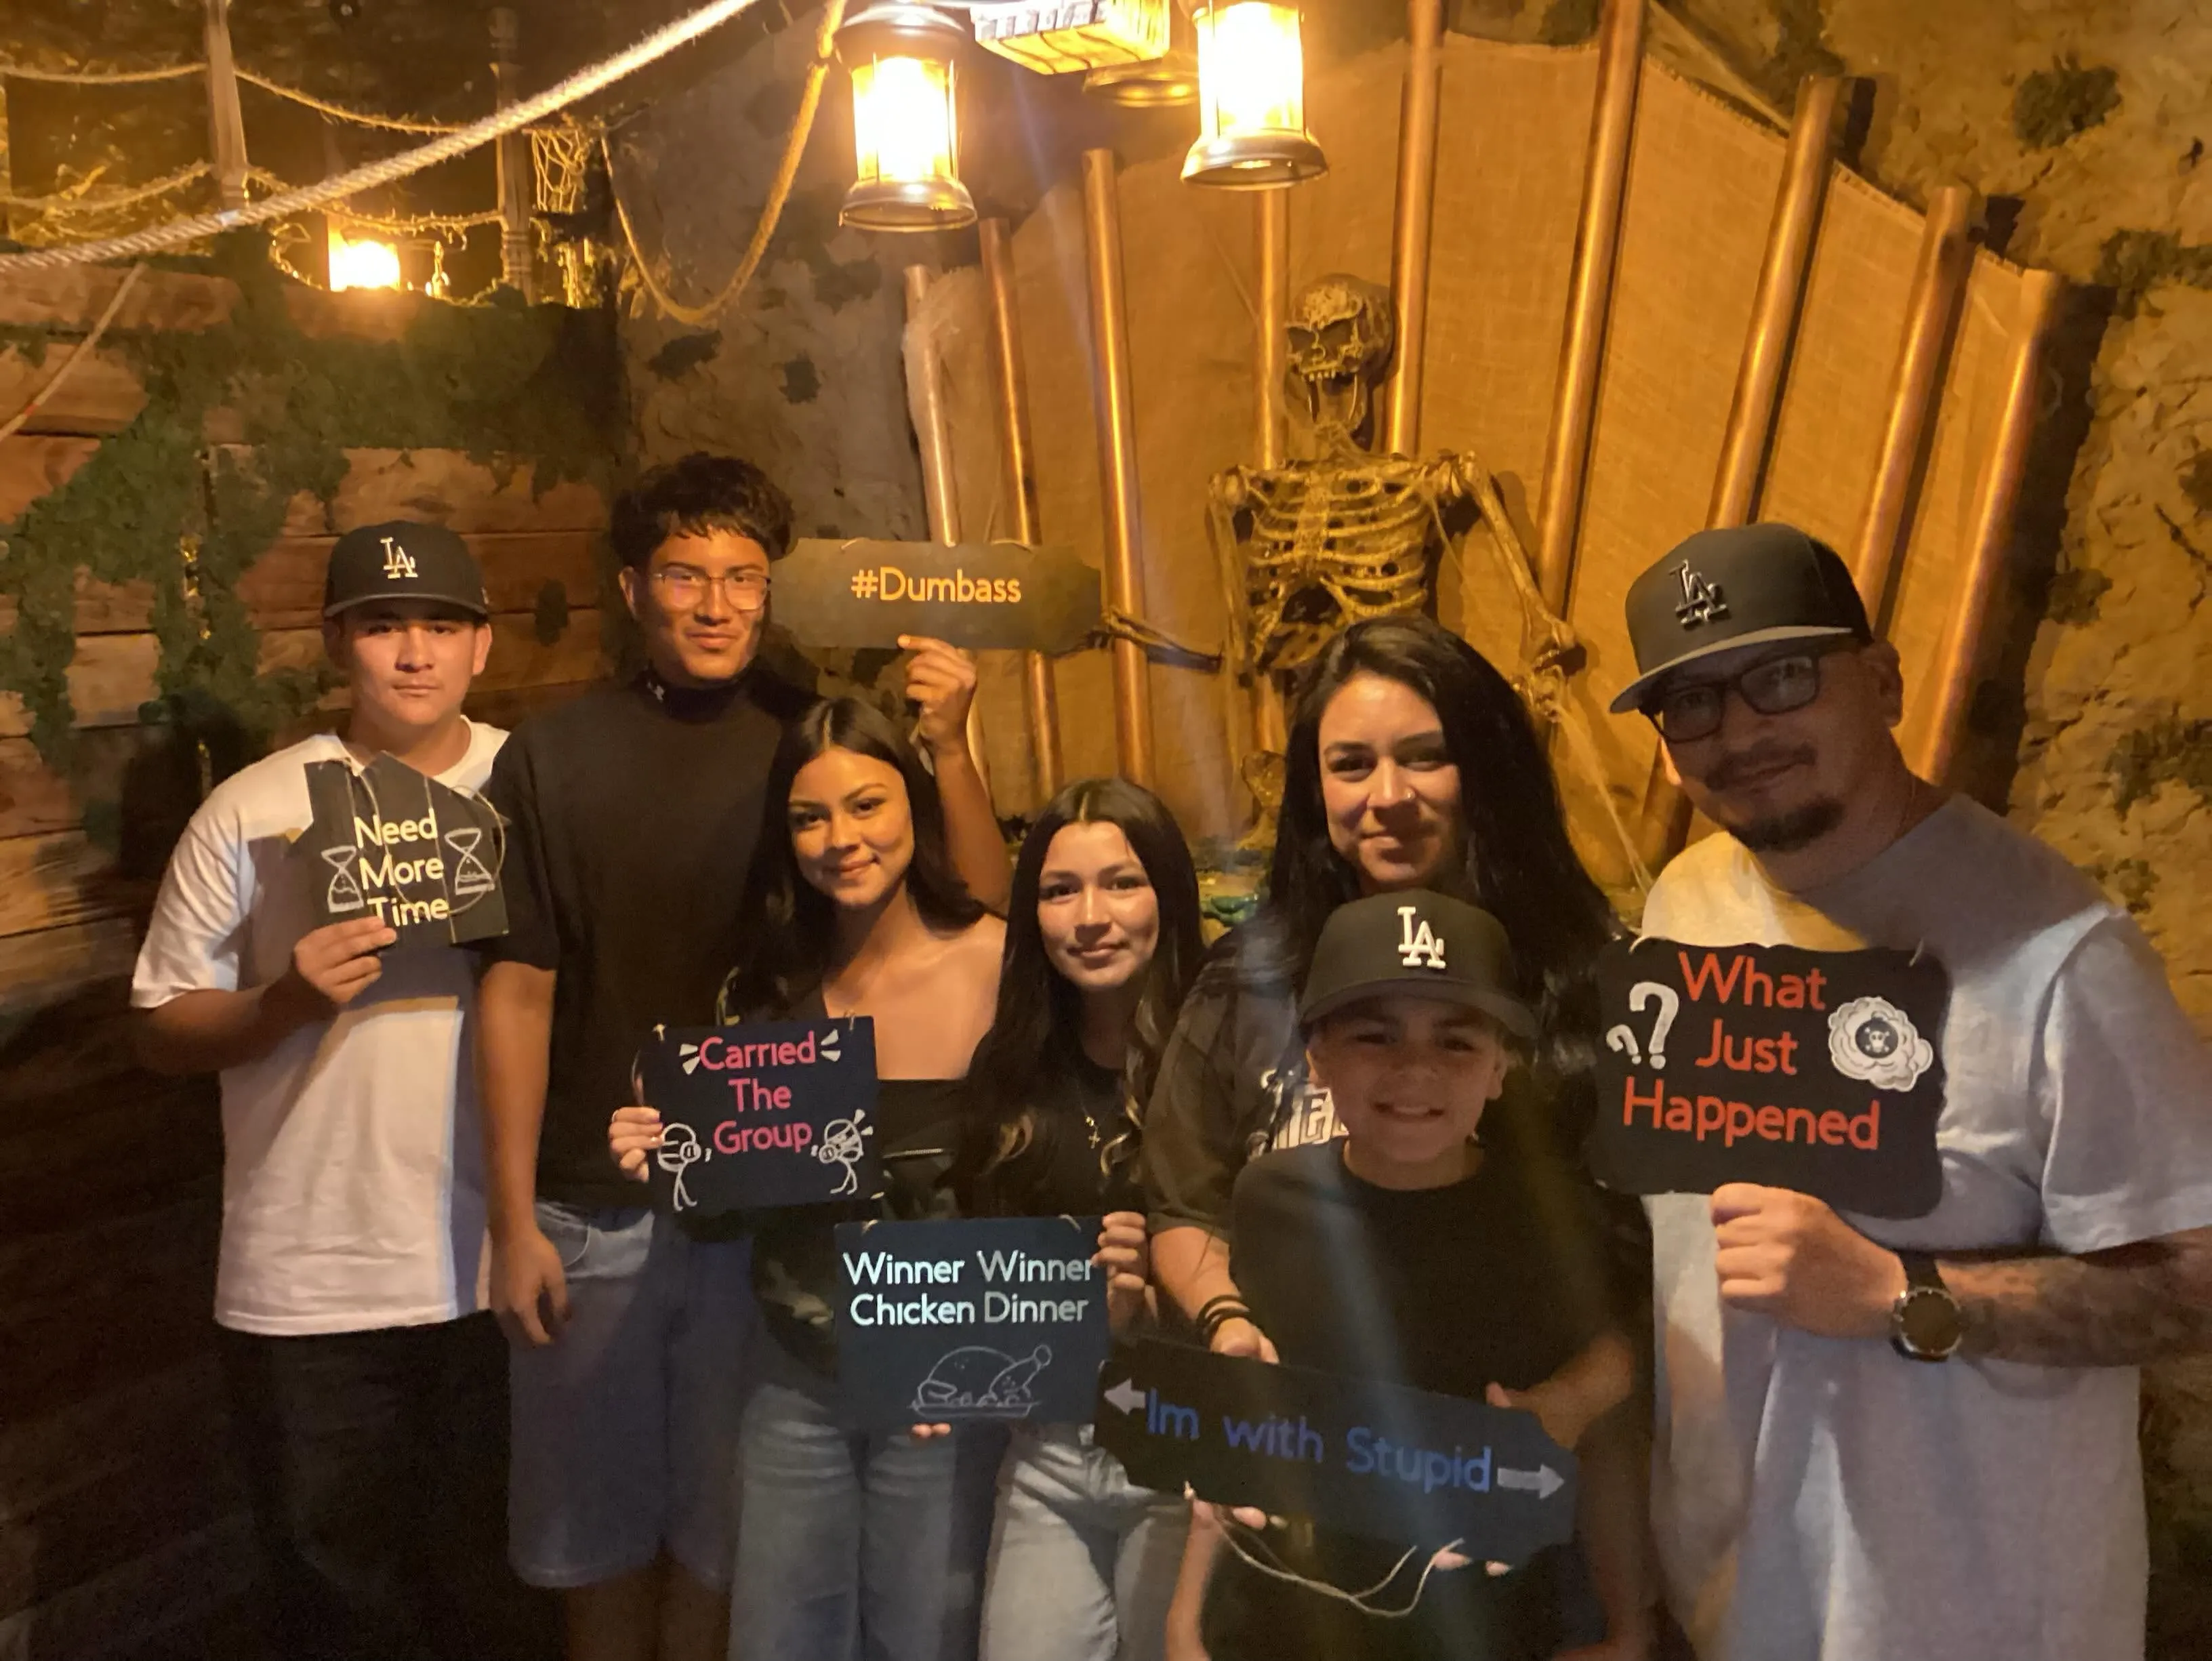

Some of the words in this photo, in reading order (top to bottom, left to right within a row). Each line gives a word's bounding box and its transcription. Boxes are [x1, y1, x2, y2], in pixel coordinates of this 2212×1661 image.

[380, 537, 418, 579] LA
[851, 567, 1021, 602] #Dumbass
[1668, 559, 1727, 625] LA
[354, 808, 438, 848] Need
[359, 855, 445, 890] More
[367, 897, 449, 926] Time
[1397, 906, 1446, 969] LA
[1678, 951, 1826, 1010] What
[699, 1030, 816, 1070] Carried
[1696, 1018, 1799, 1075] Just
[729, 1078, 792, 1112] The
[1623, 1076, 1881, 1150] Happened
[714, 1120, 813, 1154] Group
[843, 1251, 965, 1285] Winner
[977, 1250, 1093, 1282] Winner
[851, 1292, 975, 1326] Chicken
[984, 1291, 1089, 1323] Dinner
[1145, 1387, 1200, 1441] Im
[1223, 1412, 1324, 1463] with
[1346, 1427, 1492, 1494] Stupid
